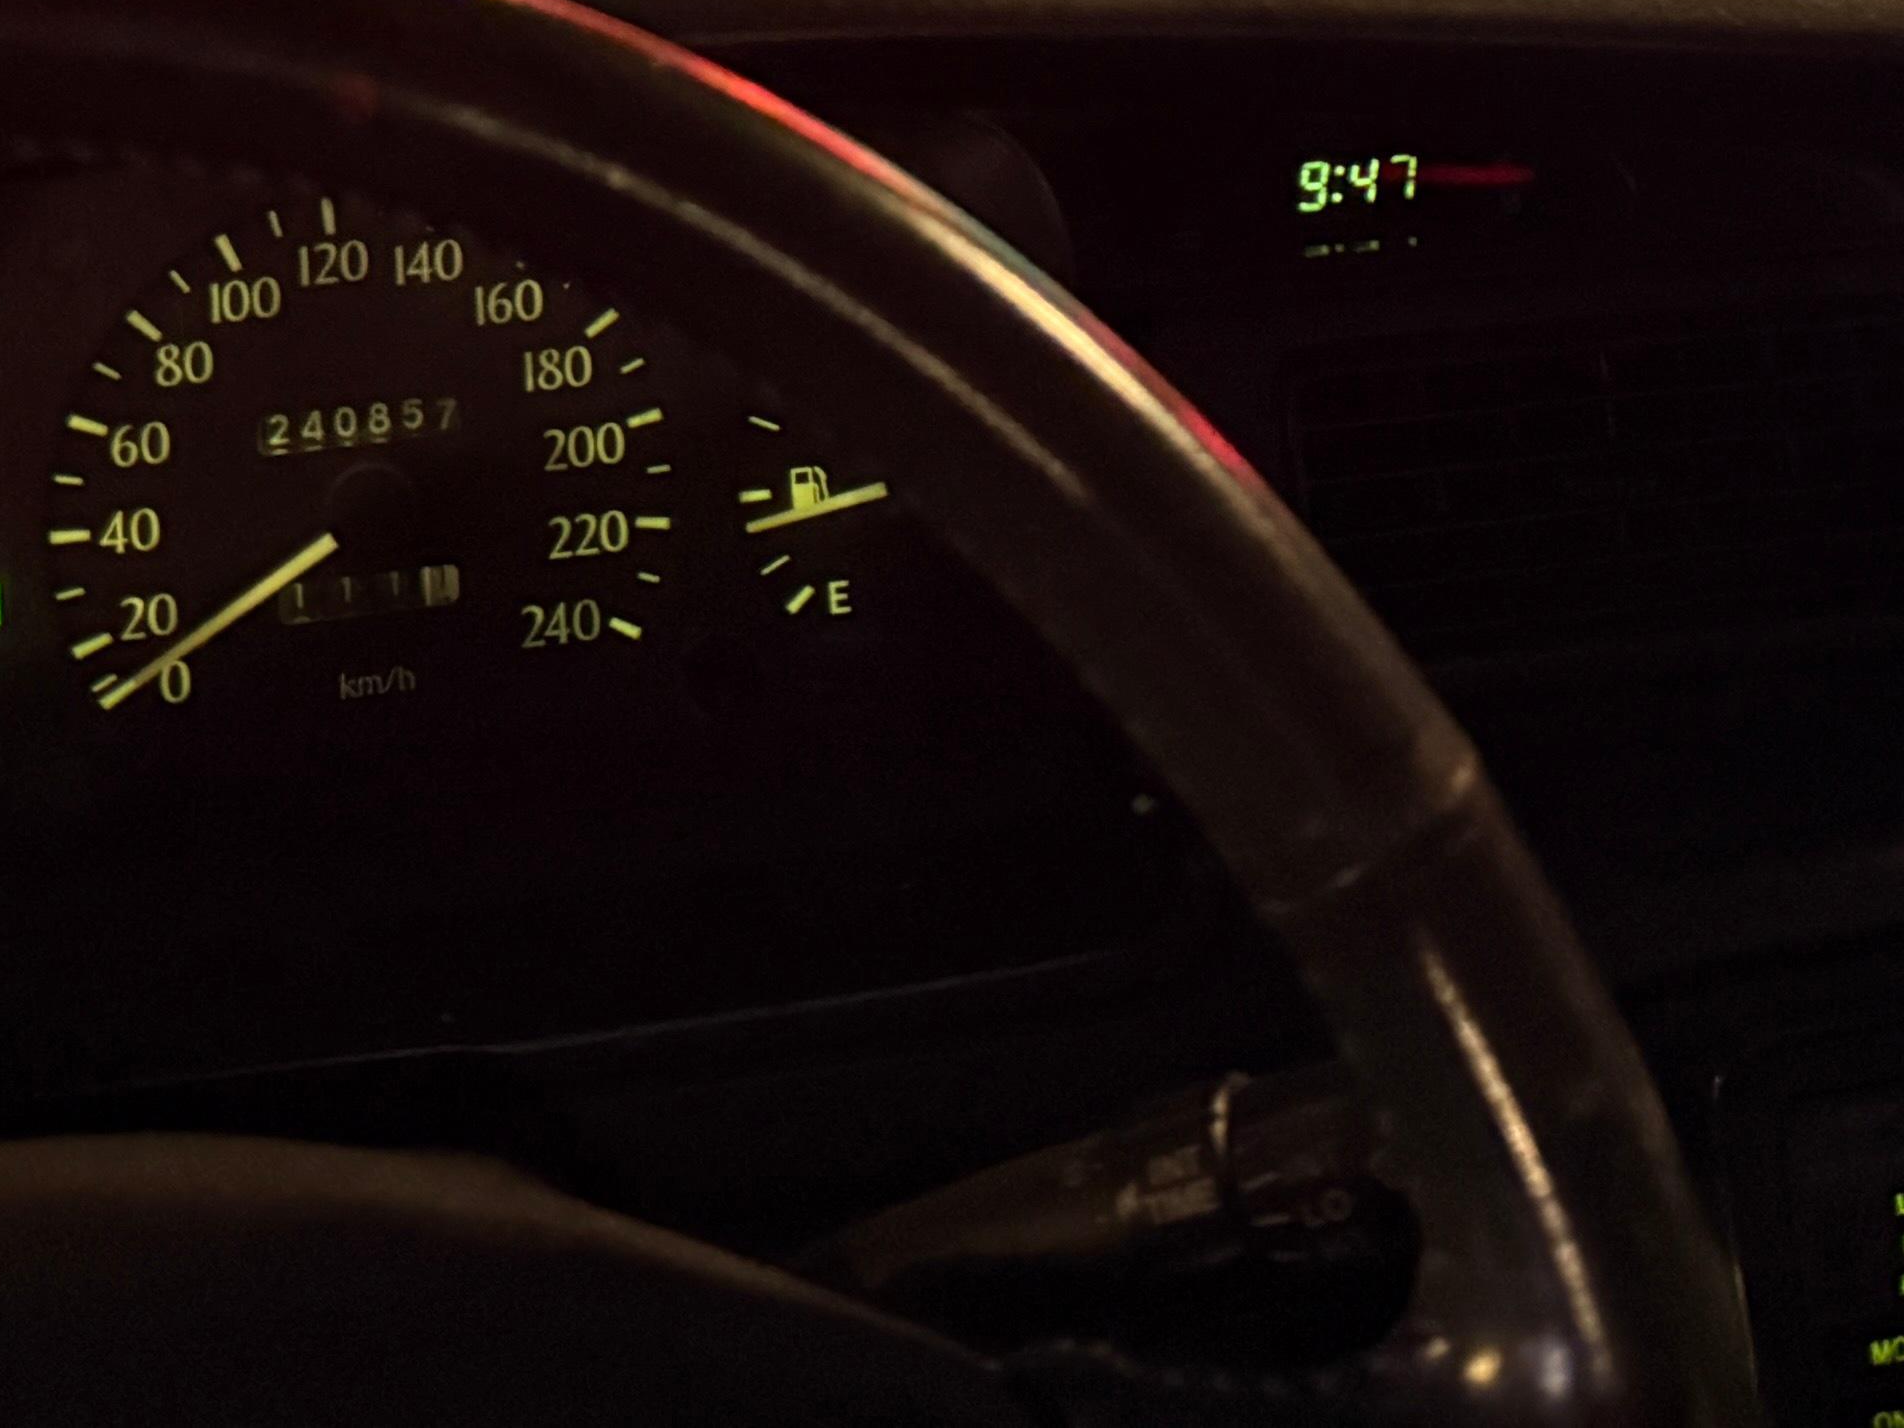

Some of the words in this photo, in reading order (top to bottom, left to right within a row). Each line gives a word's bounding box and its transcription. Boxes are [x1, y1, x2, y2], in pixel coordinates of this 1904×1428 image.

[1297, 154, 1419, 213] 9:47
[300, 240, 368, 286] 120
[395, 240, 463, 285] 140
[211, 277, 280, 323] 100
[476, 280, 543, 325] 160
[156, 342, 213, 386] 80
[525, 346, 592, 391] 180
[111, 422, 170, 467] 60
[546, 423, 624, 469] 200
[100, 508, 160, 553] 40
[550, 510, 628, 559] 220
[122, 594, 177, 640] 20
[828, 580, 851, 614] E
[522, 599, 600, 647] 240
[160, 663, 190, 703] 0
[339, 667, 415, 699] km/h
